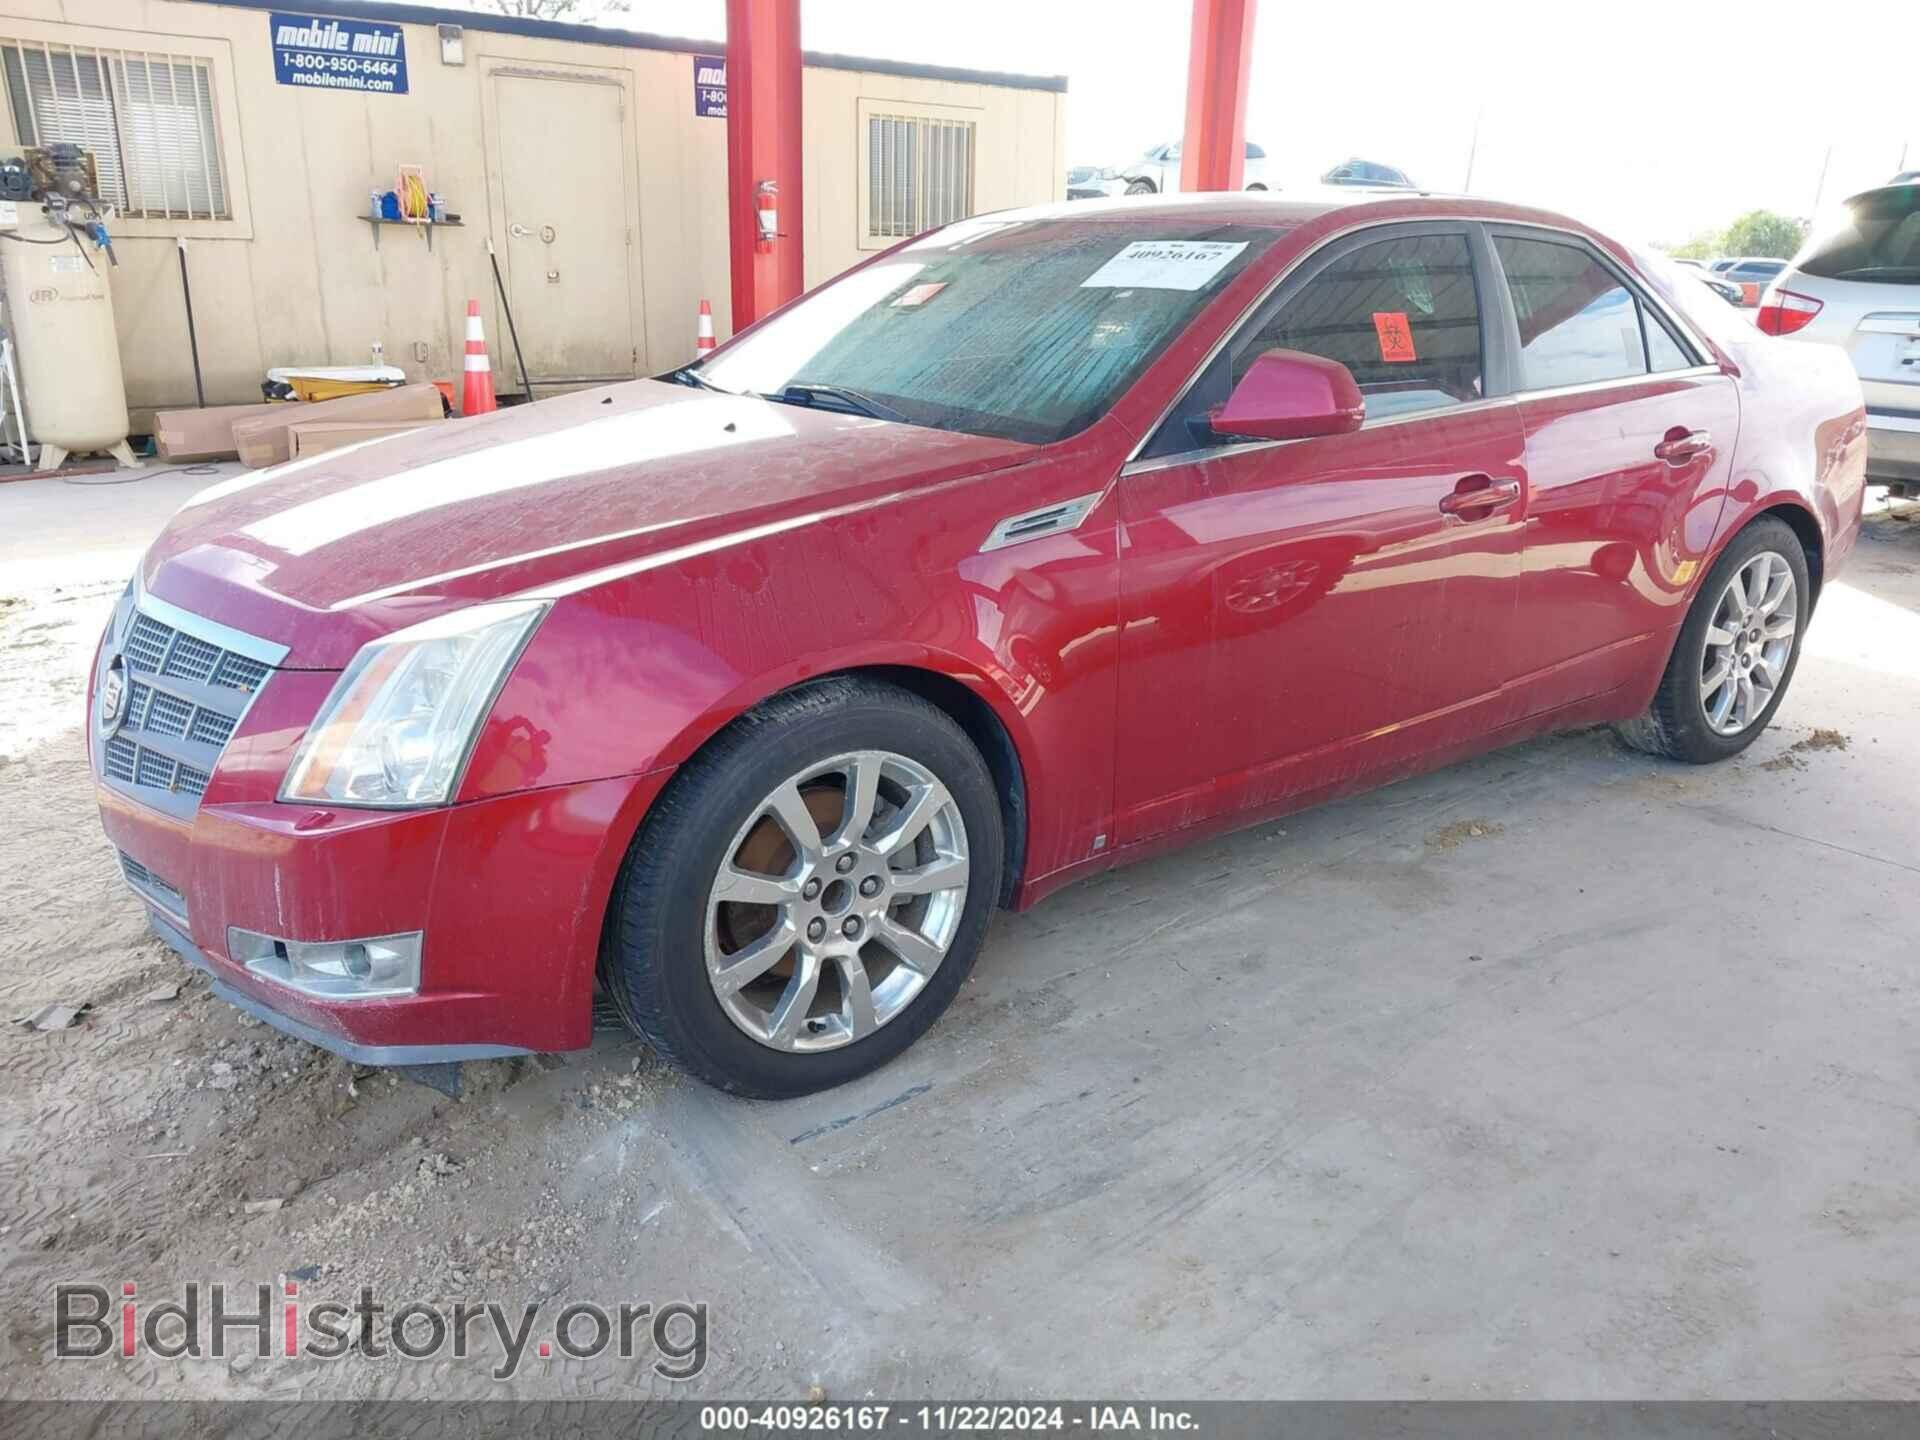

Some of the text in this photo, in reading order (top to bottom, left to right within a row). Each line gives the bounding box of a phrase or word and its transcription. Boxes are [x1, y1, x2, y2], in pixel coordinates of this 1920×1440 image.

[276, 19, 401, 56] mobile mini
[283, 53, 398, 76] 1-800-950-6464
[292, 71, 394, 91] mobilemini.com
